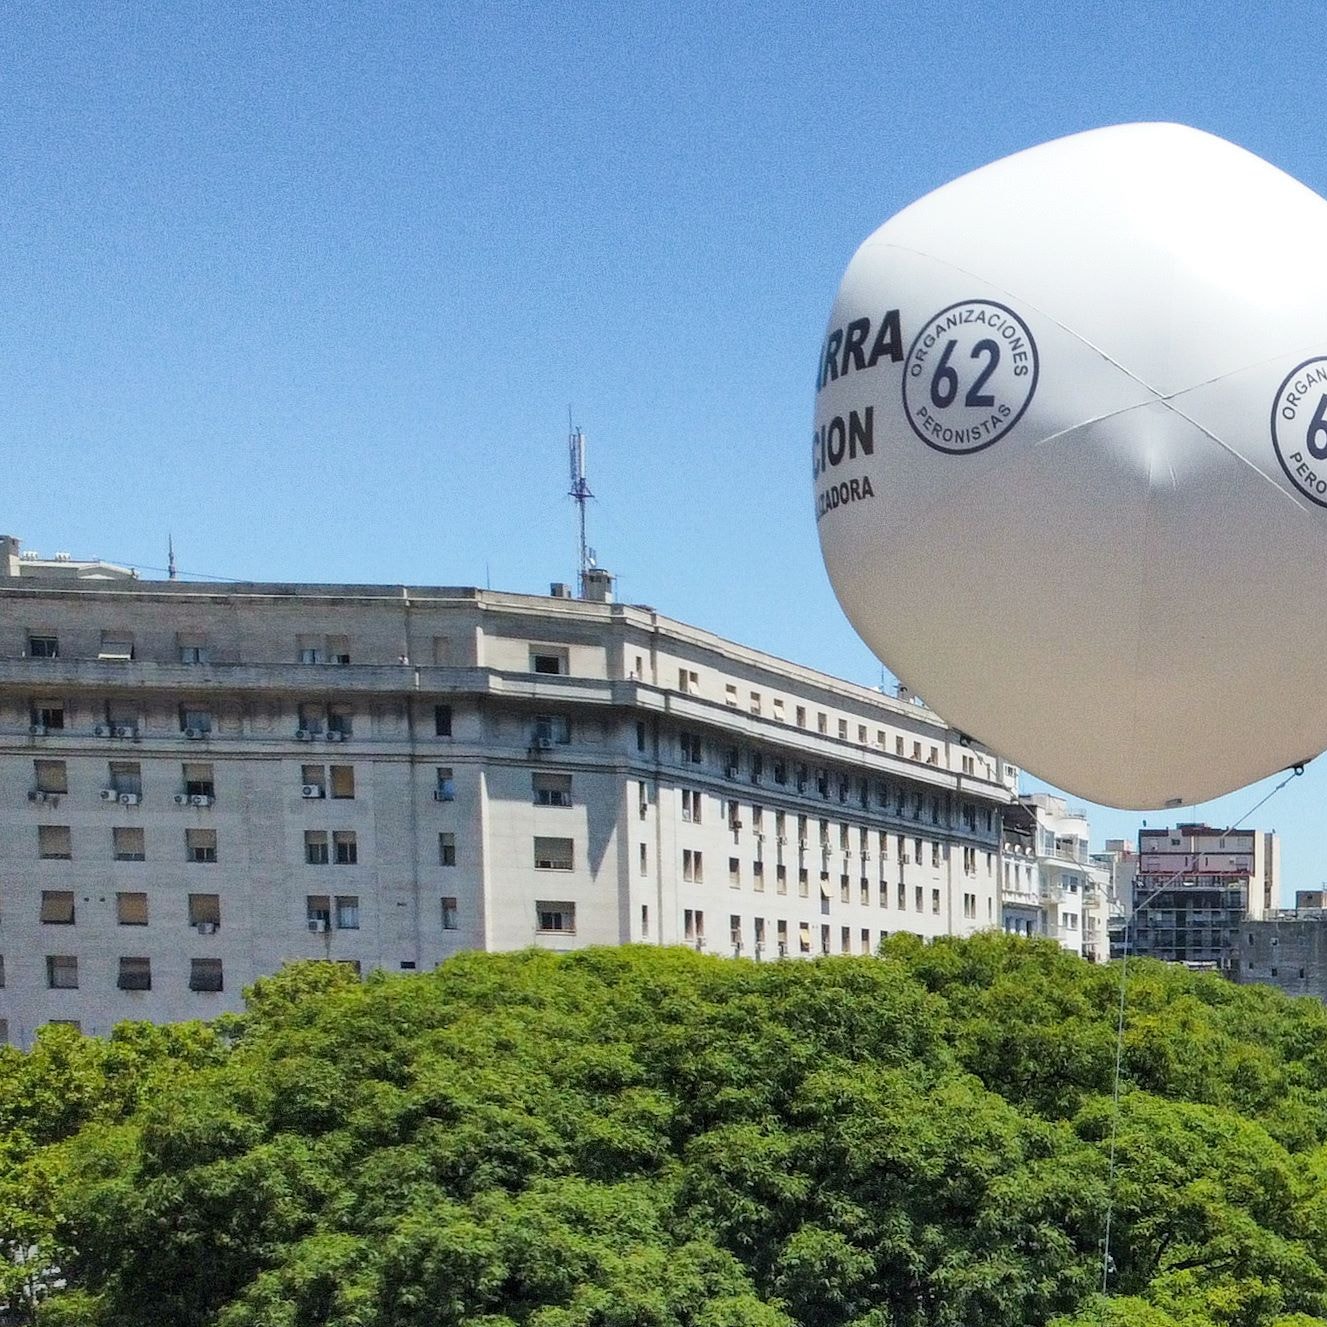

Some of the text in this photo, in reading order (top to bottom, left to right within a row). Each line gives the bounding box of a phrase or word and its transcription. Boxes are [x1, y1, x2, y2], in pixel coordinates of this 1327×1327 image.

[909, 307, 1029, 378] ORGANIZACIONES
[930, 338, 1001, 410] 62
[916, 402, 1012, 445] PERONISTAS
